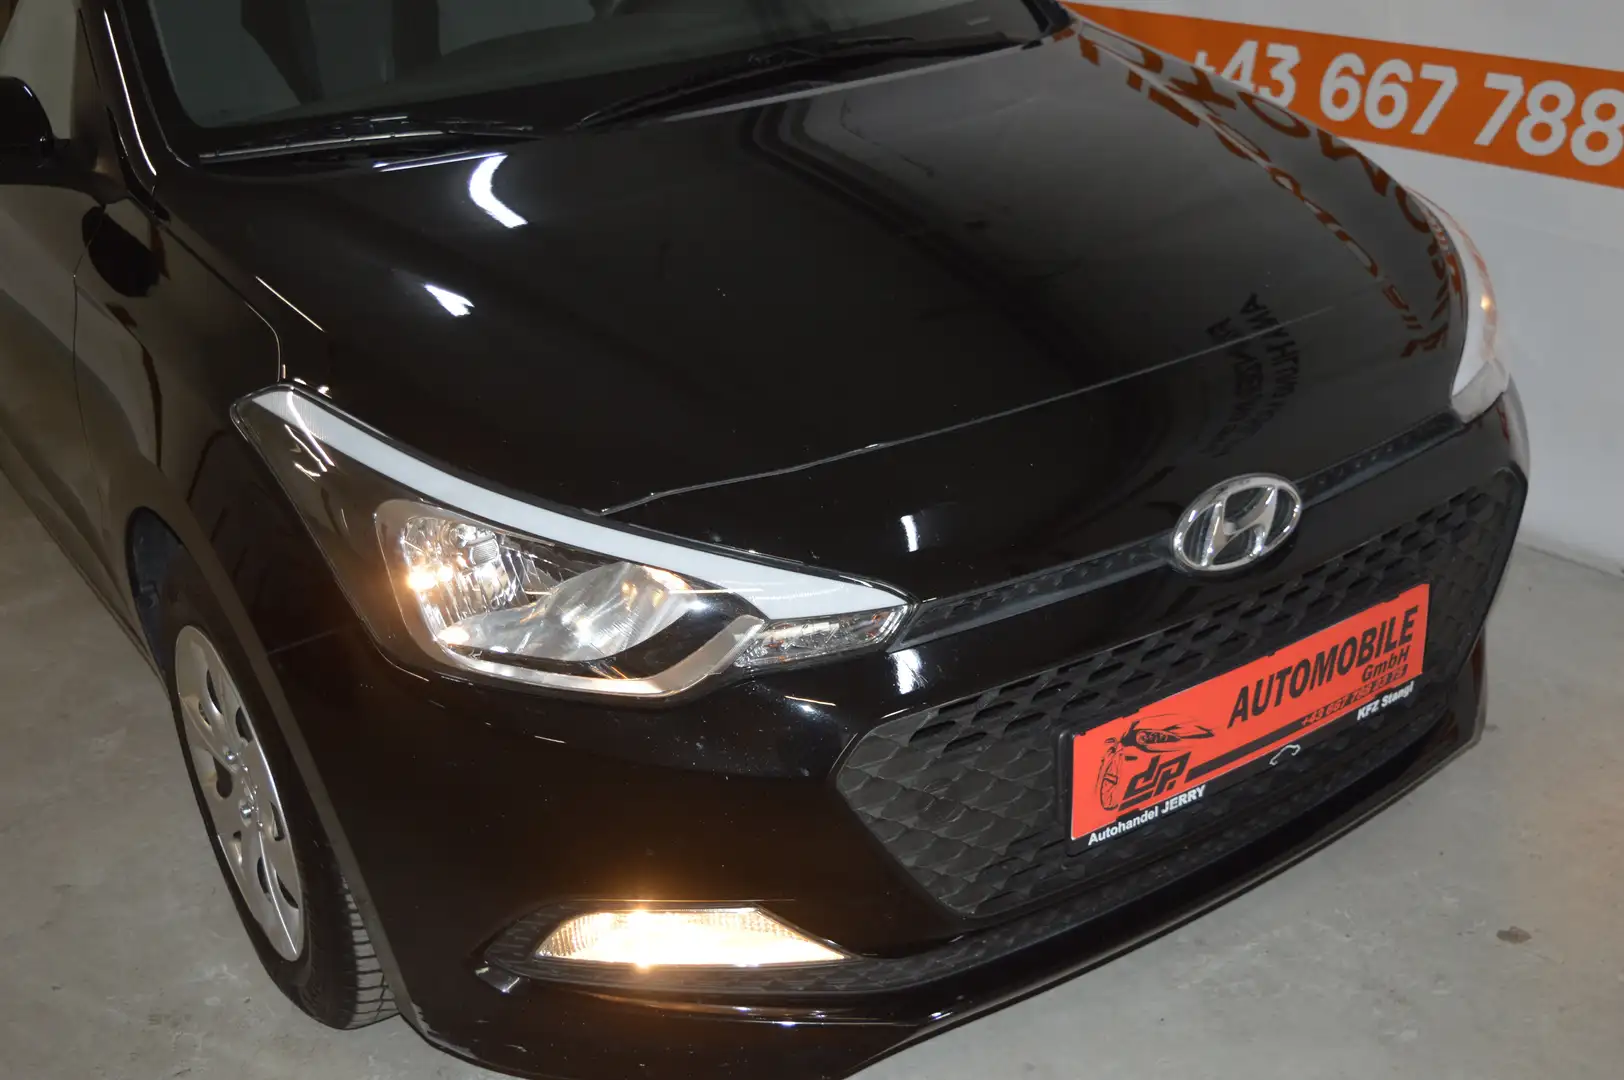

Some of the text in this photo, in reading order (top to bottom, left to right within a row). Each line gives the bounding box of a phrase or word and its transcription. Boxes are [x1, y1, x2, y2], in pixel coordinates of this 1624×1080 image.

[1319, 53, 1458, 136] 667
[1473, 72, 1624, 166] 788
[1226, 604, 1419, 729] AUTOMOBILE
[1361, 645, 1411, 683] GmbH
[1356, 698, 1381, 721] KFZ
[1087, 784, 1206, 846] Autohandel JERRY
